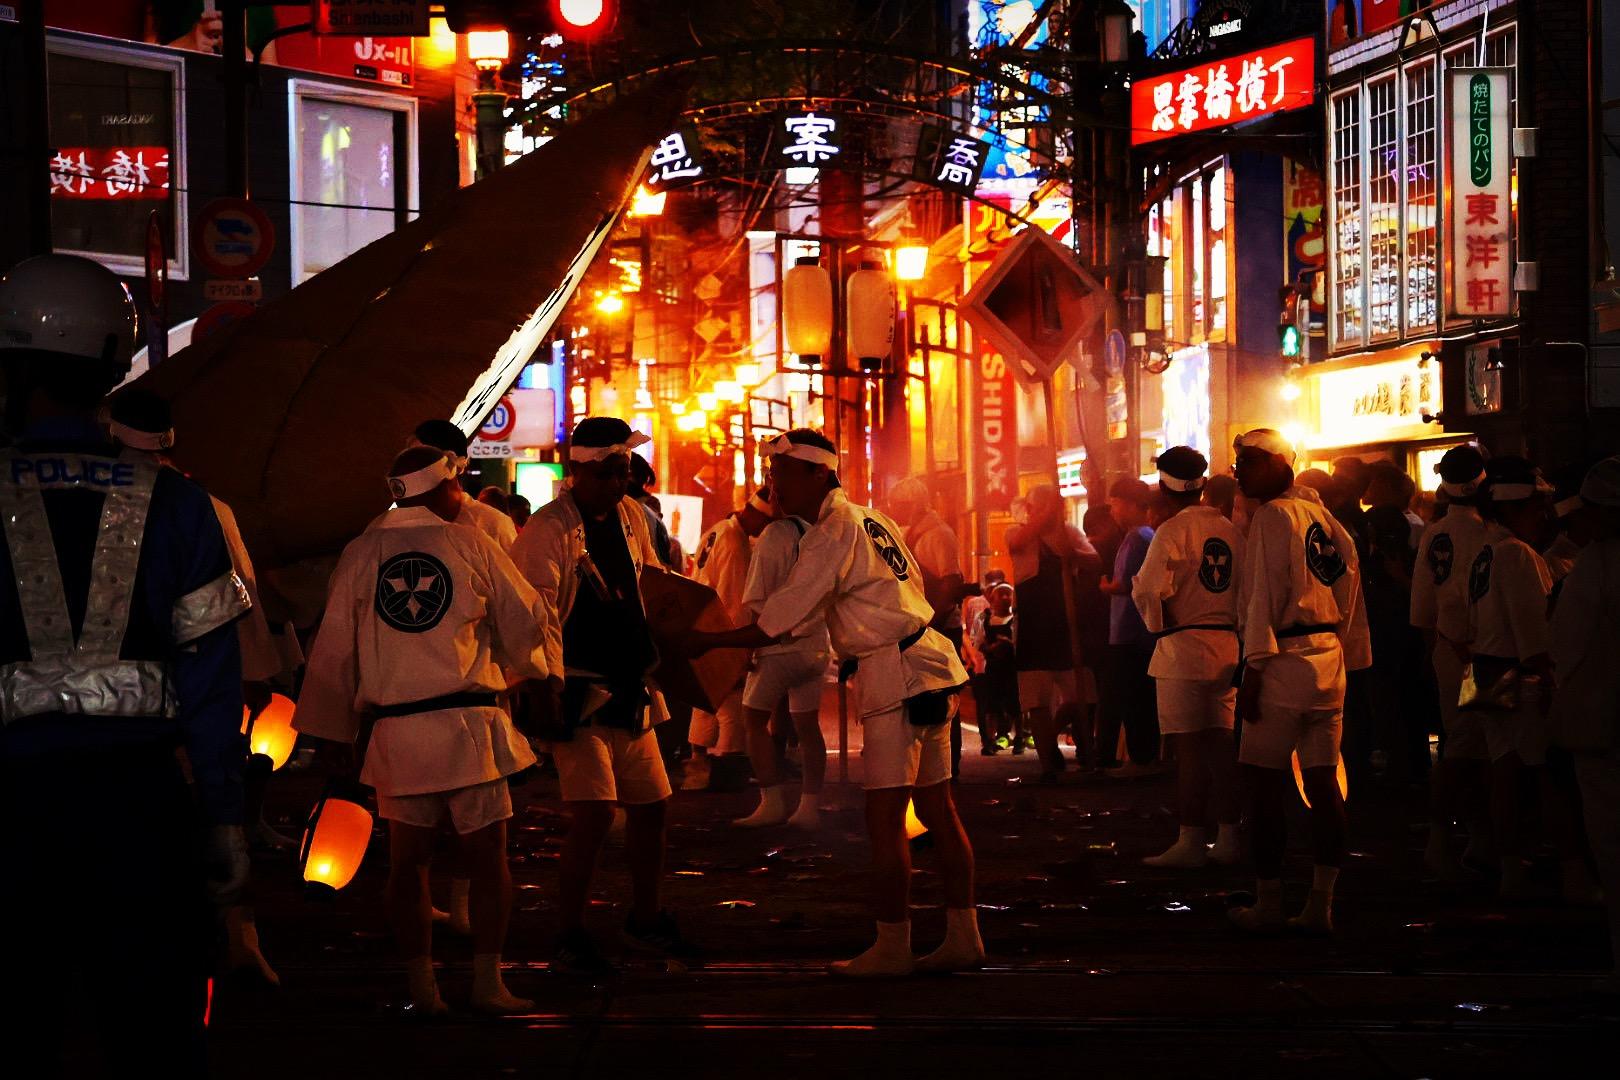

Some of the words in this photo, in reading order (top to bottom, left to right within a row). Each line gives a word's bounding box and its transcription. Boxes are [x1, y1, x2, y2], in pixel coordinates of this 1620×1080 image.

[1209, 18, 1242, 38] NAGASAKI
[1152, 56, 1294, 131] 思案橋横丁
[1473, 83, 1489, 180] 焼たてのパン
[1465, 192, 1500, 312] 東洋軒
[472, 445, 512, 456] ここから
[981, 353, 1007, 495] SHIDAX
[12, 458, 134, 486] POLICE
